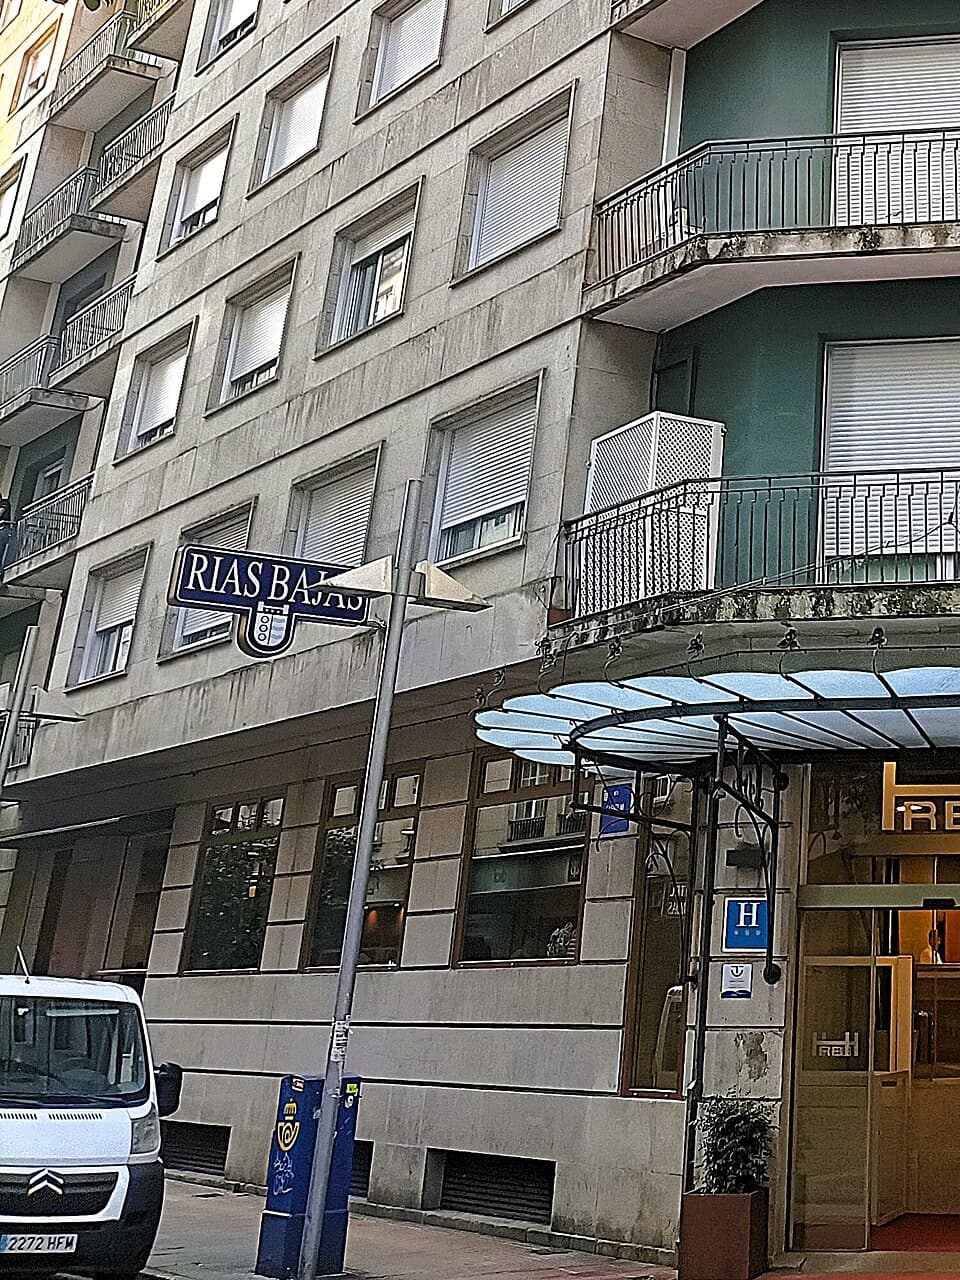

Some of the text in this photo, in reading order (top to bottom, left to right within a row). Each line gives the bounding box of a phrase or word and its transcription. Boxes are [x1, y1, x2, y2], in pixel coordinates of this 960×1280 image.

[184, 553, 263, 598] RIAS
[736, 902, 759, 927] H
[8, 1236, 44, 1251] 2272
